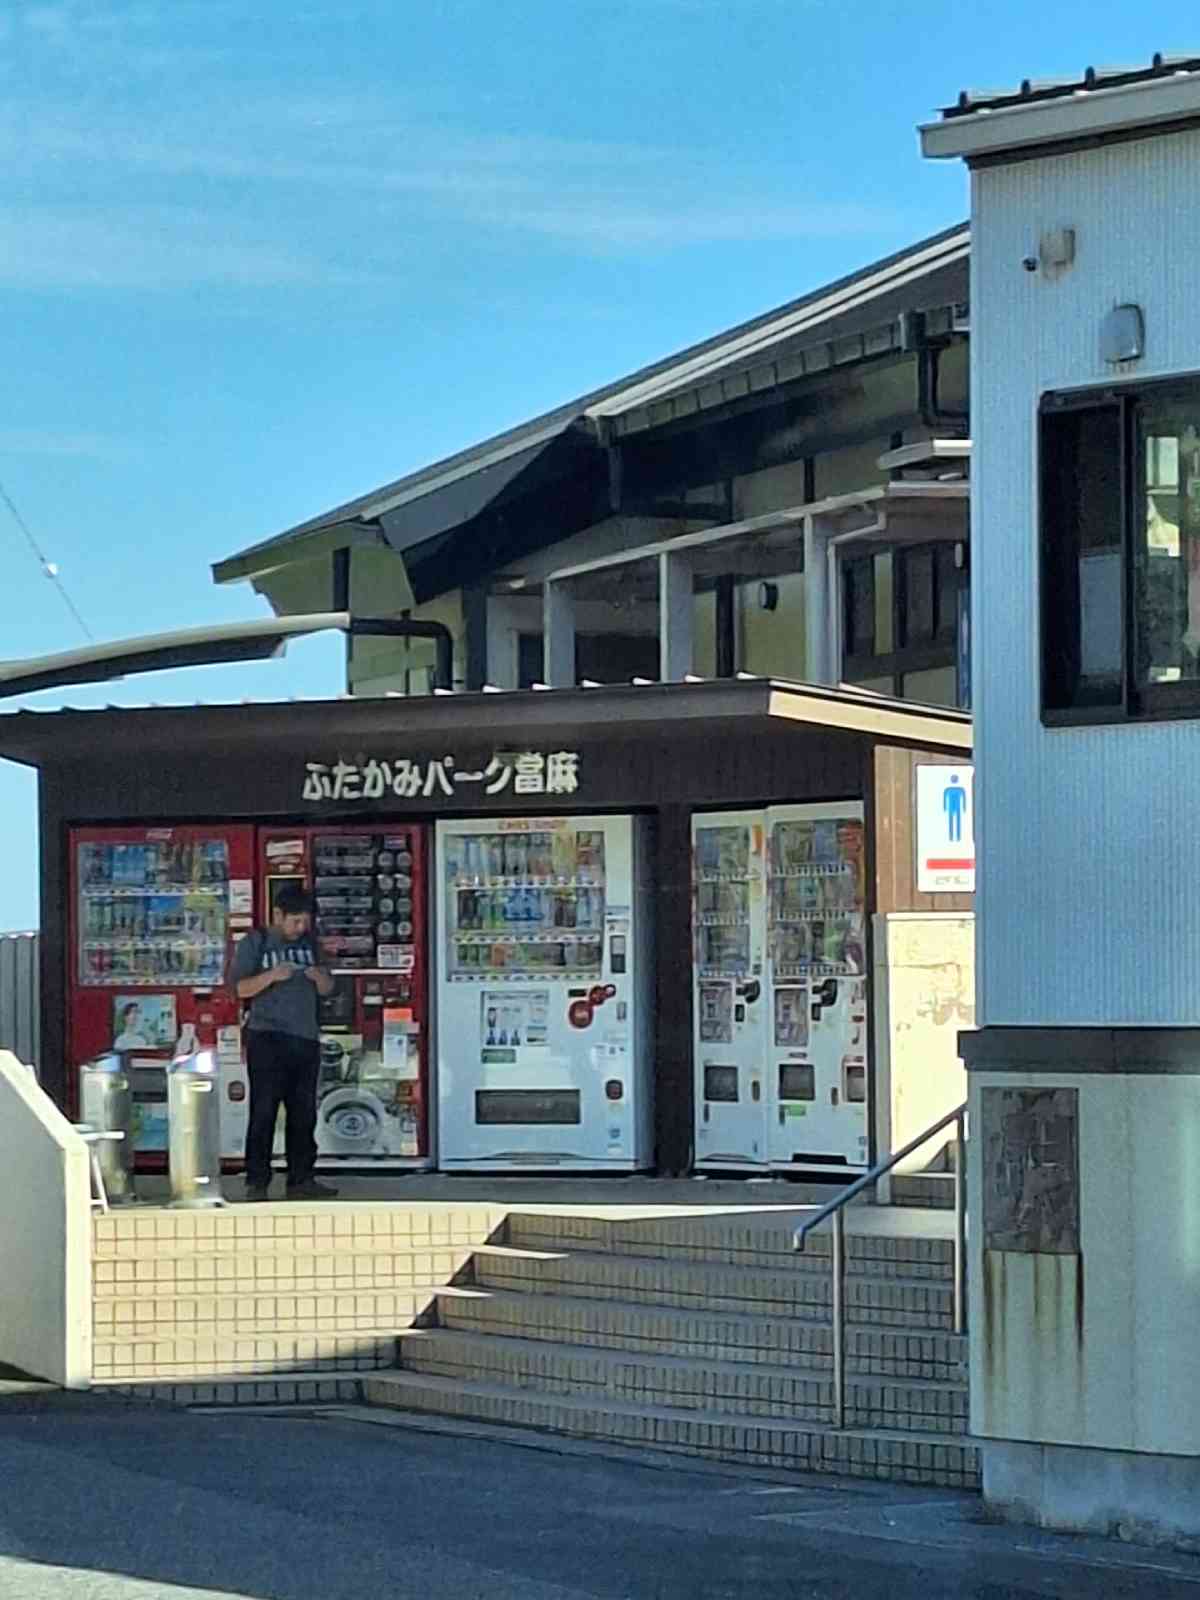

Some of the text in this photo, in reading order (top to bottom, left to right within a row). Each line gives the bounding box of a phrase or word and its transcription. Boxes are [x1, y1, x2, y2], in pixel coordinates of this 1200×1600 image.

[302, 752, 579, 800] ふたかみパーク當麻
